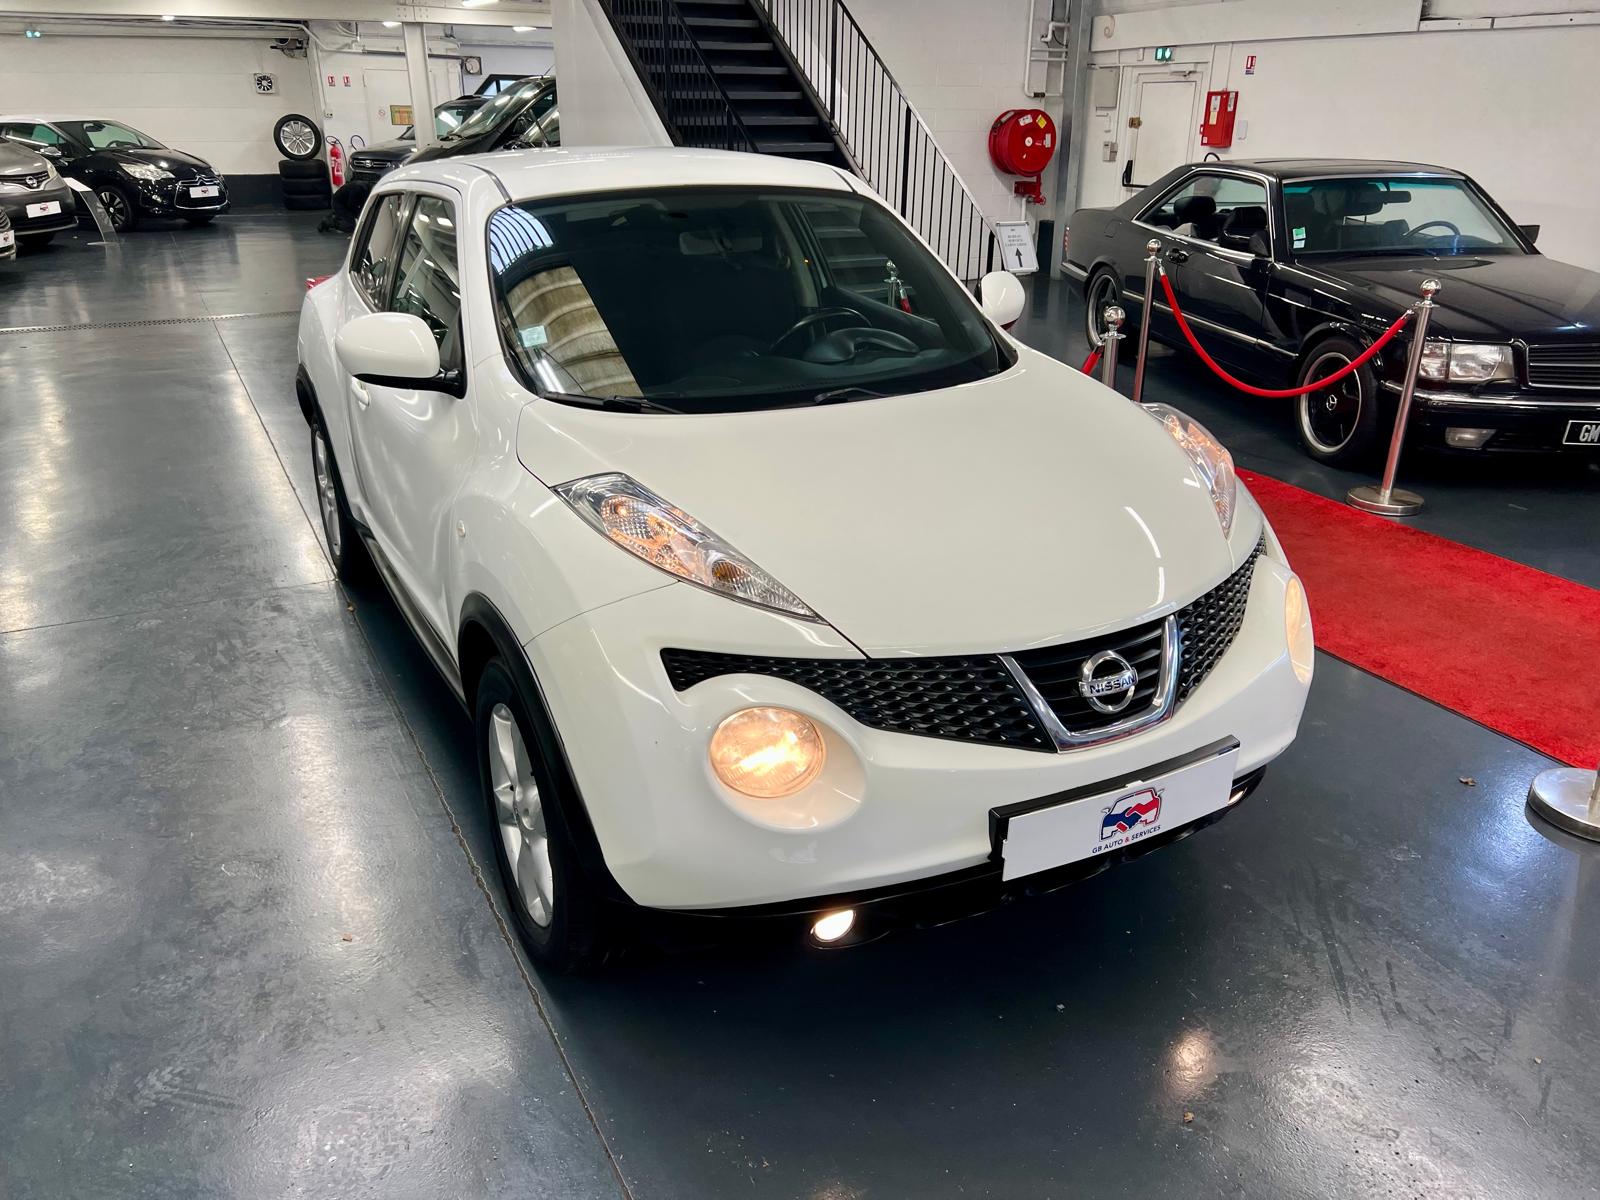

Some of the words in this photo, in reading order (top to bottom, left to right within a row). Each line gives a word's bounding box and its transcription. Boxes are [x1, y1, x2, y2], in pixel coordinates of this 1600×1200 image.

[1089, 673, 1136, 694] NISSAN
[1092, 845, 1102, 854] GB
[1103, 838, 1123, 850] AUTO
[1131, 824, 1161, 841] SERVICES
